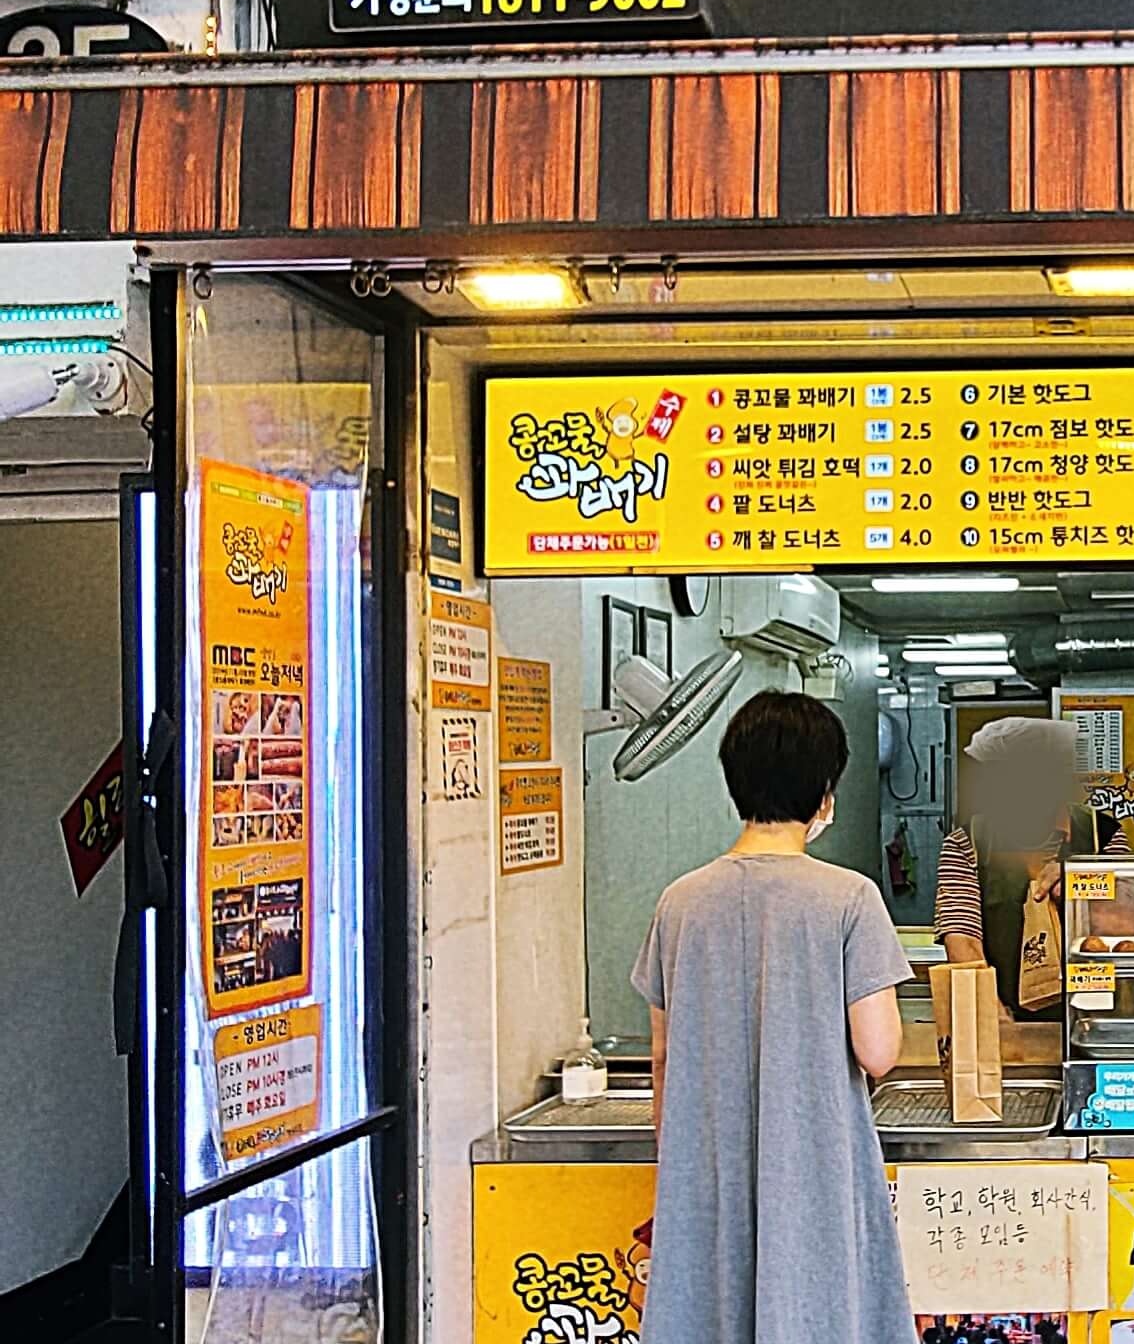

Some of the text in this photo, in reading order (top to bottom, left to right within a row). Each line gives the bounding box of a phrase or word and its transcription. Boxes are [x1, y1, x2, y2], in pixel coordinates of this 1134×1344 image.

[733, 387, 932, 408] 콩꼬물 꽈배기 2.5
[988, 384, 1027, 405] 기본
[1033, 383, 1092, 404] 핫도그
[651, 394, 682, 440] 수제
[509, 413, 607, 461] 콩꼬물
[733, 422, 932, 444] 설탕 꽈배기 2.5
[989, 421, 1044, 438] 17cm
[1050, 419, 1089, 440] 점보
[732, 458, 772, 479] 씨앗
[777, 458, 816, 479] 튀김
[822, 457, 861, 478] 호떡
[900, 458, 932, 475] 2.0
[989, 456, 1044, 473] 17cm
[1050, 454, 1089, 476] 청양
[516, 452, 669, 523] 꽈배기
[732, 494, 752, 515] 팥
[757, 493, 817, 514] 도너츠
[900, 493, 932, 511] 2.0
[988, 489, 1027, 511] 반반
[1033, 489, 1092, 510] 핫도그
[732, 530, 751, 550] 깨
[758, 529, 776, 550] 찰
[783, 529, 842, 549] 도너츠
[899, 529, 932, 546] 4.0
[989, 528, 1044, 545] 15cm
[1050, 525, 1109, 547] 통치즈
[212, 644, 257, 667] MBC
[259, 661, 304, 688] 오늘저녁
[243, 1018, 289, 1045] 영업시간
[246, 1057, 260, 1071] PM
[246, 1080, 260, 1093] PM
[927, 1222, 1030, 1254] 각종 모임등
[513, 1253, 628, 1312] 콩꼬물
